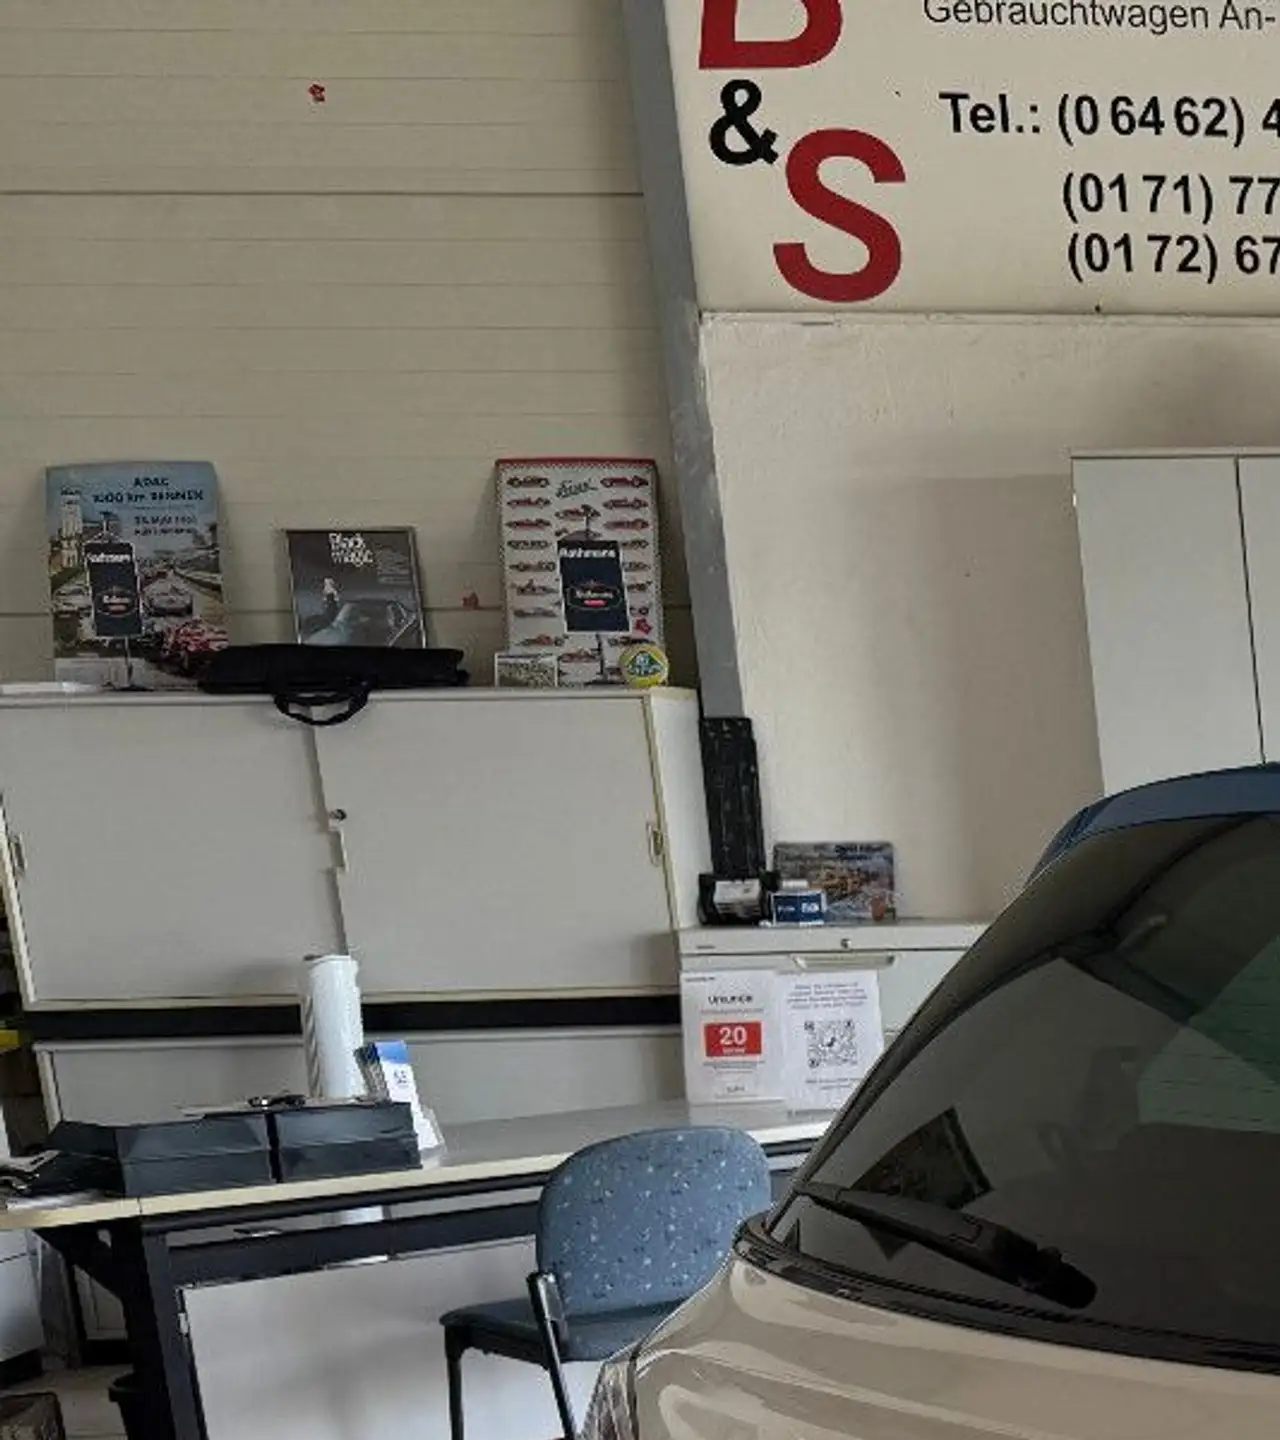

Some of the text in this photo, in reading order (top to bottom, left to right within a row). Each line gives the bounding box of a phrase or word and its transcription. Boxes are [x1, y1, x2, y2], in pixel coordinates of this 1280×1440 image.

[923, 0, 1209, 35] Gebrauchtwagen
[1219, 0, 1275, 30] An-
[708, 79, 778, 165] &
[939, 92, 1041, 133] Tel.:
[773, 129, 906, 304] S
[719, 1026, 748, 1045] 20
